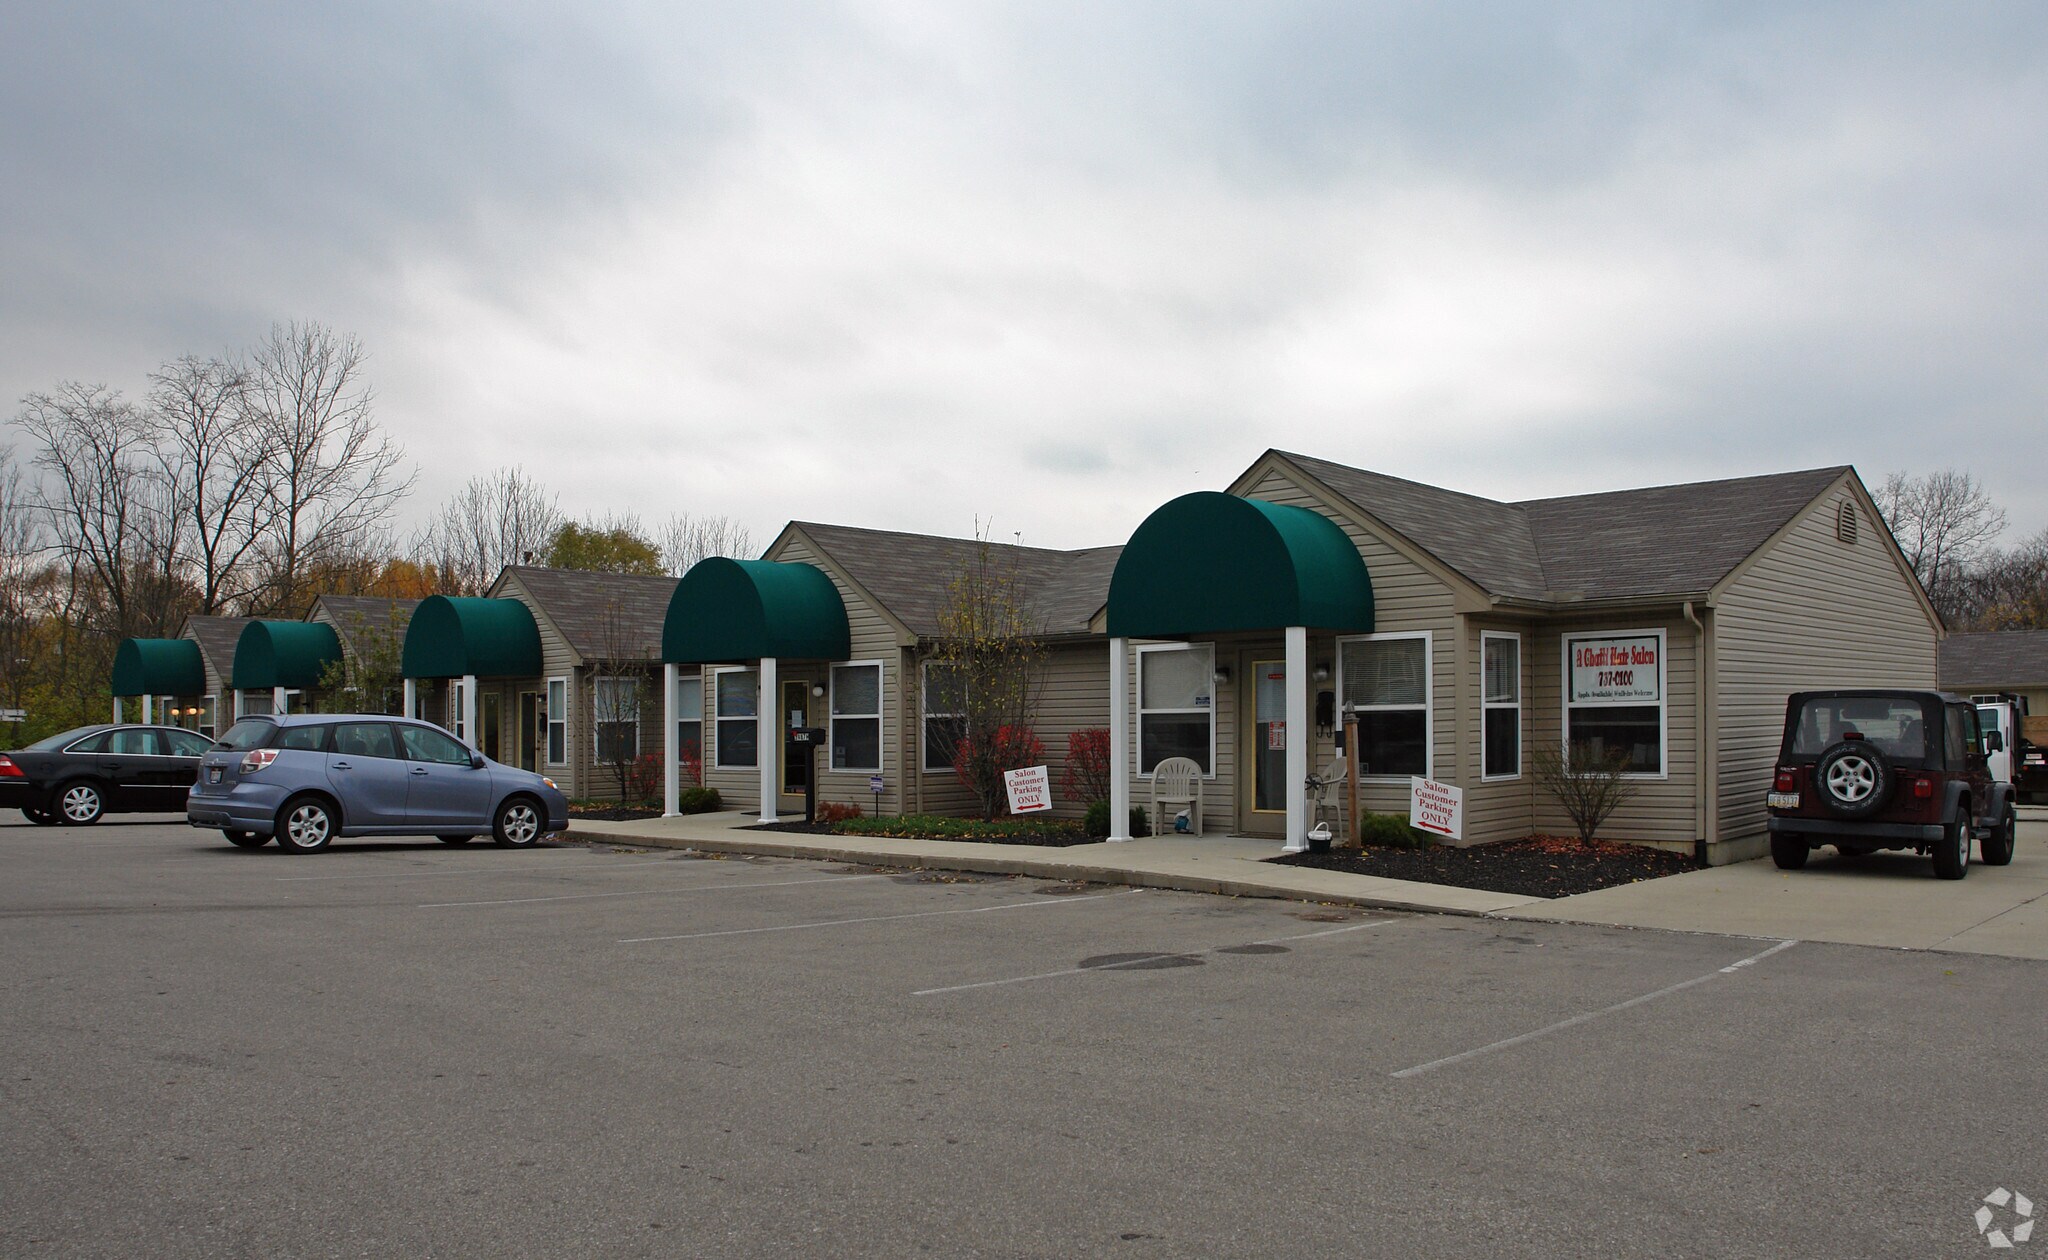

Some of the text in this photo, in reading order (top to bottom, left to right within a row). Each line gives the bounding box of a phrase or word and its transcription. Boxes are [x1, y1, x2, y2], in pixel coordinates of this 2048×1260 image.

[1576, 648, 1582, 667] A
[1610, 647, 1629, 665] Hair
[1631, 645, 1655, 665] Salon
[1599, 670, 1634, 687] 737-0100
[1014, 769, 1036, 778] Salon
[1009, 777, 1044, 787] Customer
[1423, 780, 1449, 794] Salon
[1014, 785, 1042, 794] Parking
[1415, 787, 1458, 806] Customer
[1017, 794, 1040, 804] ONLY
[1418, 798, 1453, 818] Parking
[1421, 811, 1450, 825] ONLY
